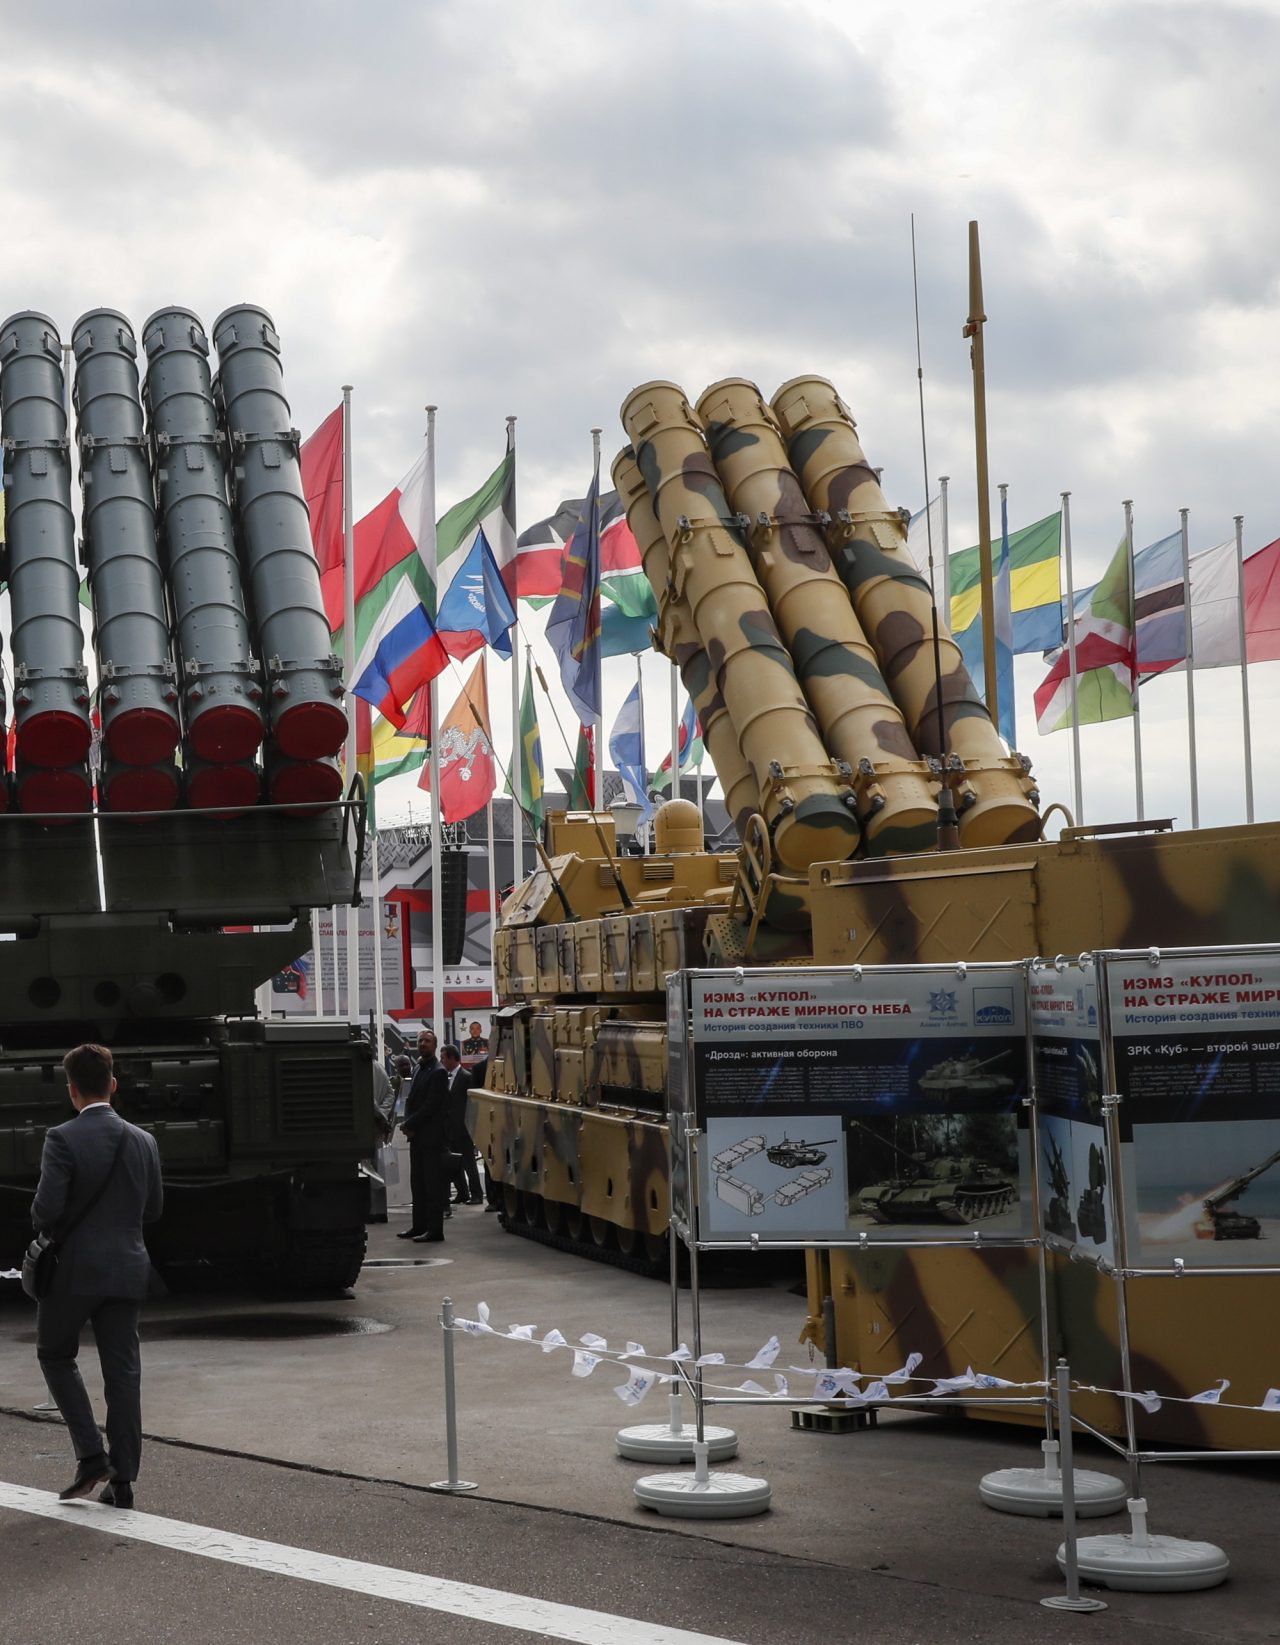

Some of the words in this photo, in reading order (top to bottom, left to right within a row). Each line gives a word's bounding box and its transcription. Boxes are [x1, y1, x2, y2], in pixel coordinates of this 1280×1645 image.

[1123, 977, 1174, 991] ИЭМЗ
[1180, 973, 1263, 988] «КУПОЛ»
[703, 992, 745, 1004] ИЭМЗ
[750, 991, 817, 1002] «КУПОЛ»
[1124, 996, 1149, 1008] НА
[1154, 992, 1231, 1007] СТРАЖЕ
[703, 1006, 727, 1019] НА
[728, 1005, 791, 1018] СТРАЖЕ
[794, 1004, 868, 1017] МИРНОГО
[872, 1003, 912, 1015] НЕБА
[1125, 1014, 1177, 1025] История
[1180, 1011, 1238, 1023] создания
[703, 1021, 746, 1033] История
[747, 1021, 796, 1032] создания
[798, 1020, 839, 1030] техники
[841, 1020, 864, 1030] ПВО
[705, 1051, 749, 1061] «Дрозд»:
[751, 1050, 795, 1059] активная
[797, 1048, 838, 1060] оборона
[1127, 1046, 1151, 1056] ЗРК
[1154, 1044, 1189, 1057] «Куб»
[1207, 1042, 1249, 1055] второй
